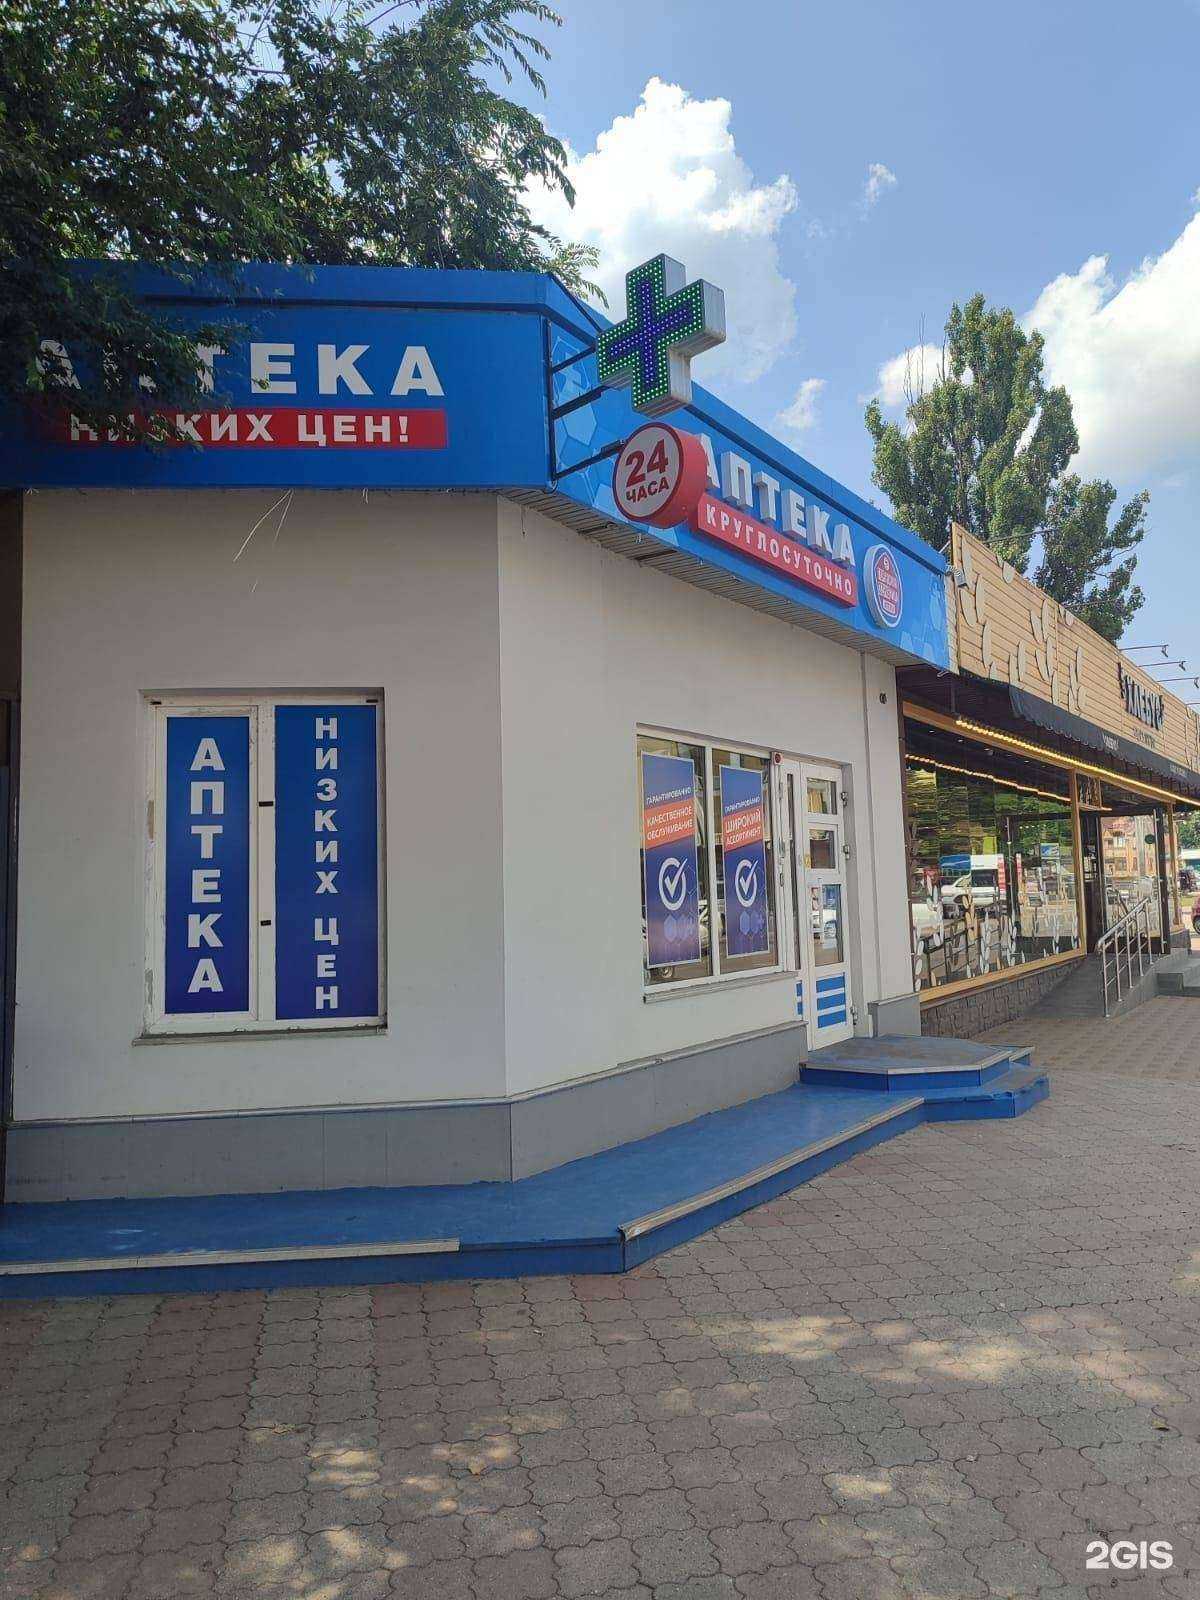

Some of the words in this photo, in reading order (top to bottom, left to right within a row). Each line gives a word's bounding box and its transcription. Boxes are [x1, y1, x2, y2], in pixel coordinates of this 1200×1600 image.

[30, 340, 445, 396] АТЕКА
[297, 414, 409, 446] ЦЕН!
[626, 439, 669, 488] 24
[626, 477, 669, 503] ЧАСА
[705, 503, 852, 596] КРУГЛОСУТОЧНО
[314, 717, 338, 894] НИЗКИХ
[647, 806, 692, 828] КАЧЕСТВЕННОЕ
[725, 808, 761, 835] ШИРОКИЙ
[647, 819, 693, 841] ОБСЛУЖИВАНИЕ
[726, 826, 761, 845] АССОРТИМЕНТ
[187, 738, 226, 993] АПТЕКА
[314, 917, 339, 1010] ЦЕН
